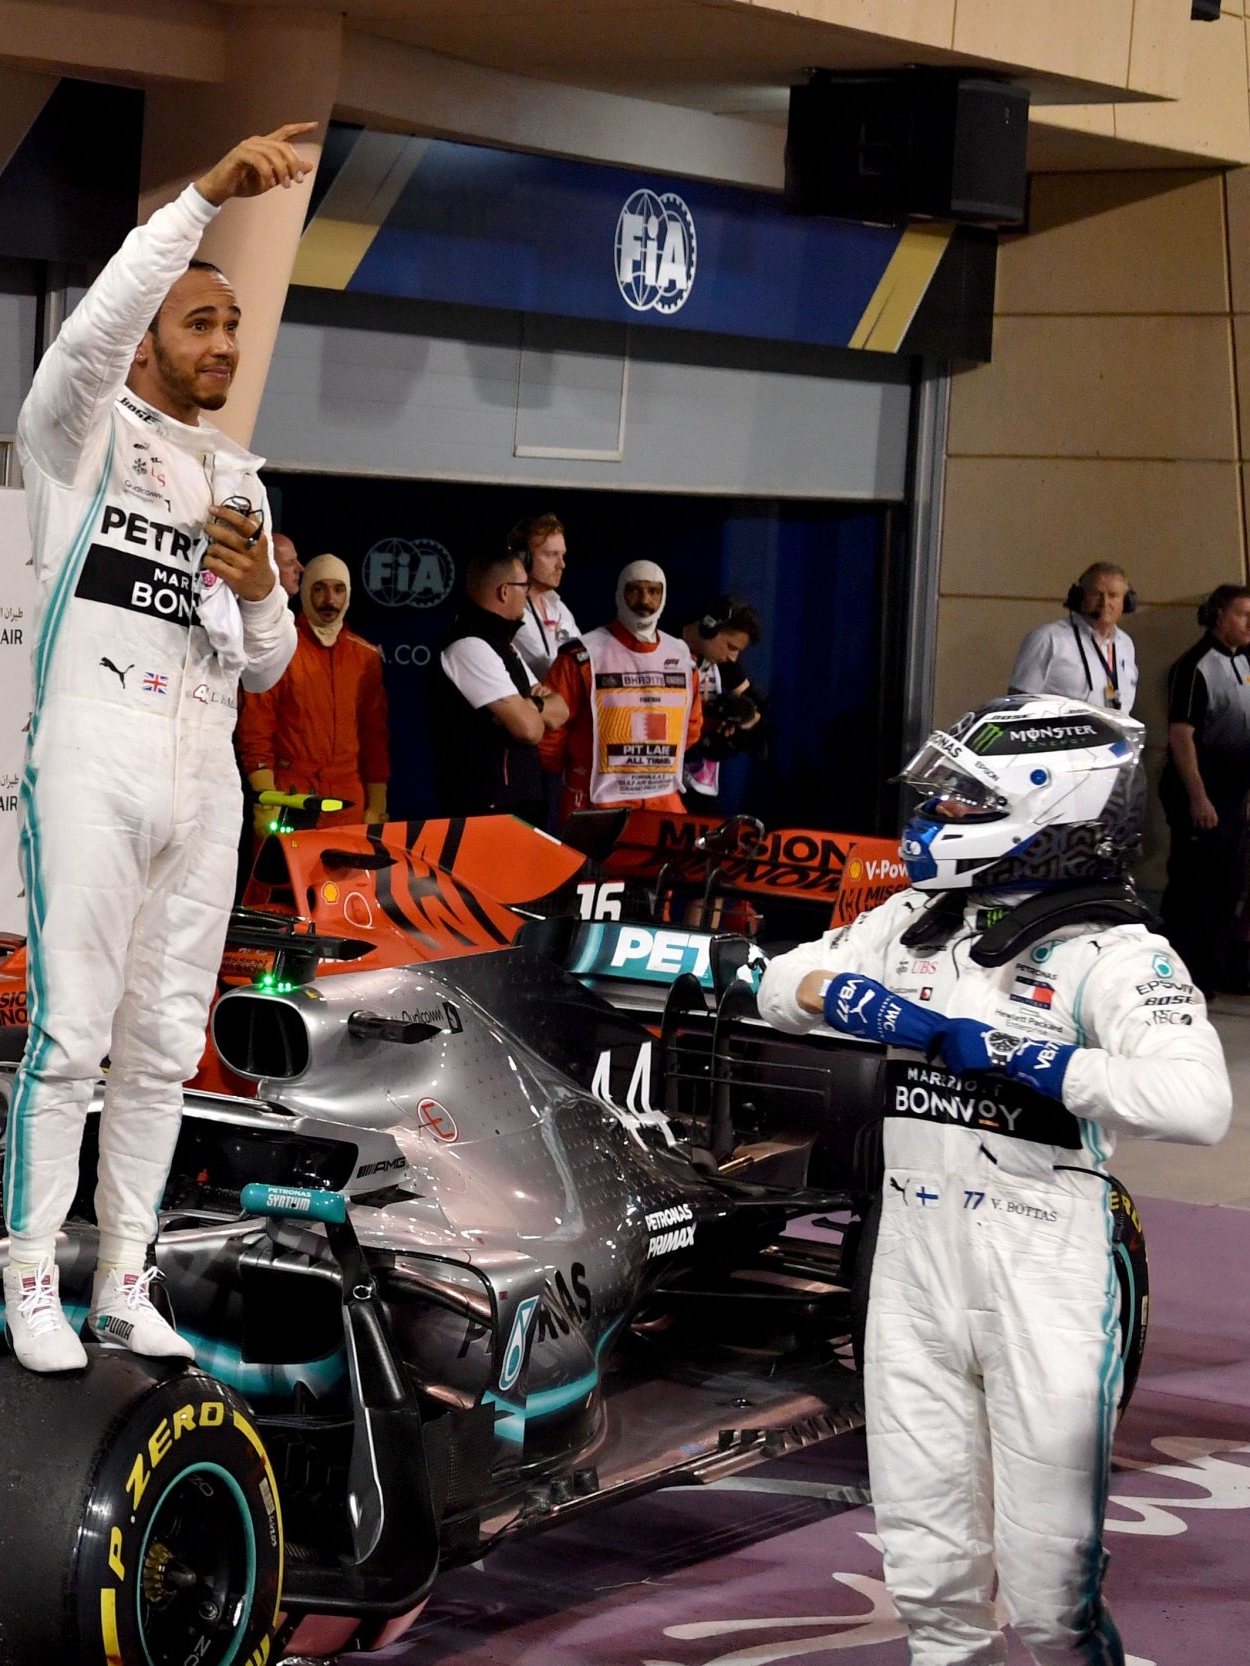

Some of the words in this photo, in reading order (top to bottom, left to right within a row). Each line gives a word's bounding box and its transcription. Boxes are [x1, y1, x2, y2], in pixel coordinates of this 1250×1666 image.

[4, 607, 24, 624] طيران
[0, 628, 23, 646] AIR
[865, 860, 908, 880] V-Pow
[577, 881, 625, 921] 16
[911, 961, 938, 974] UBS
[895, 1085, 1023, 1131] BONVOY
[374, 1157, 406, 1173] AMG
[267, 1187, 312, 1198] PETRONAS
[644, 1203, 694, 1232] PETRONAS
[964, 1190, 985, 1210] 77
[1006, 1201, 1058, 1222] BOTTAS
[646, 1222, 698, 1260] PRIMAX
[104, 1315, 135, 1341] PUMA
